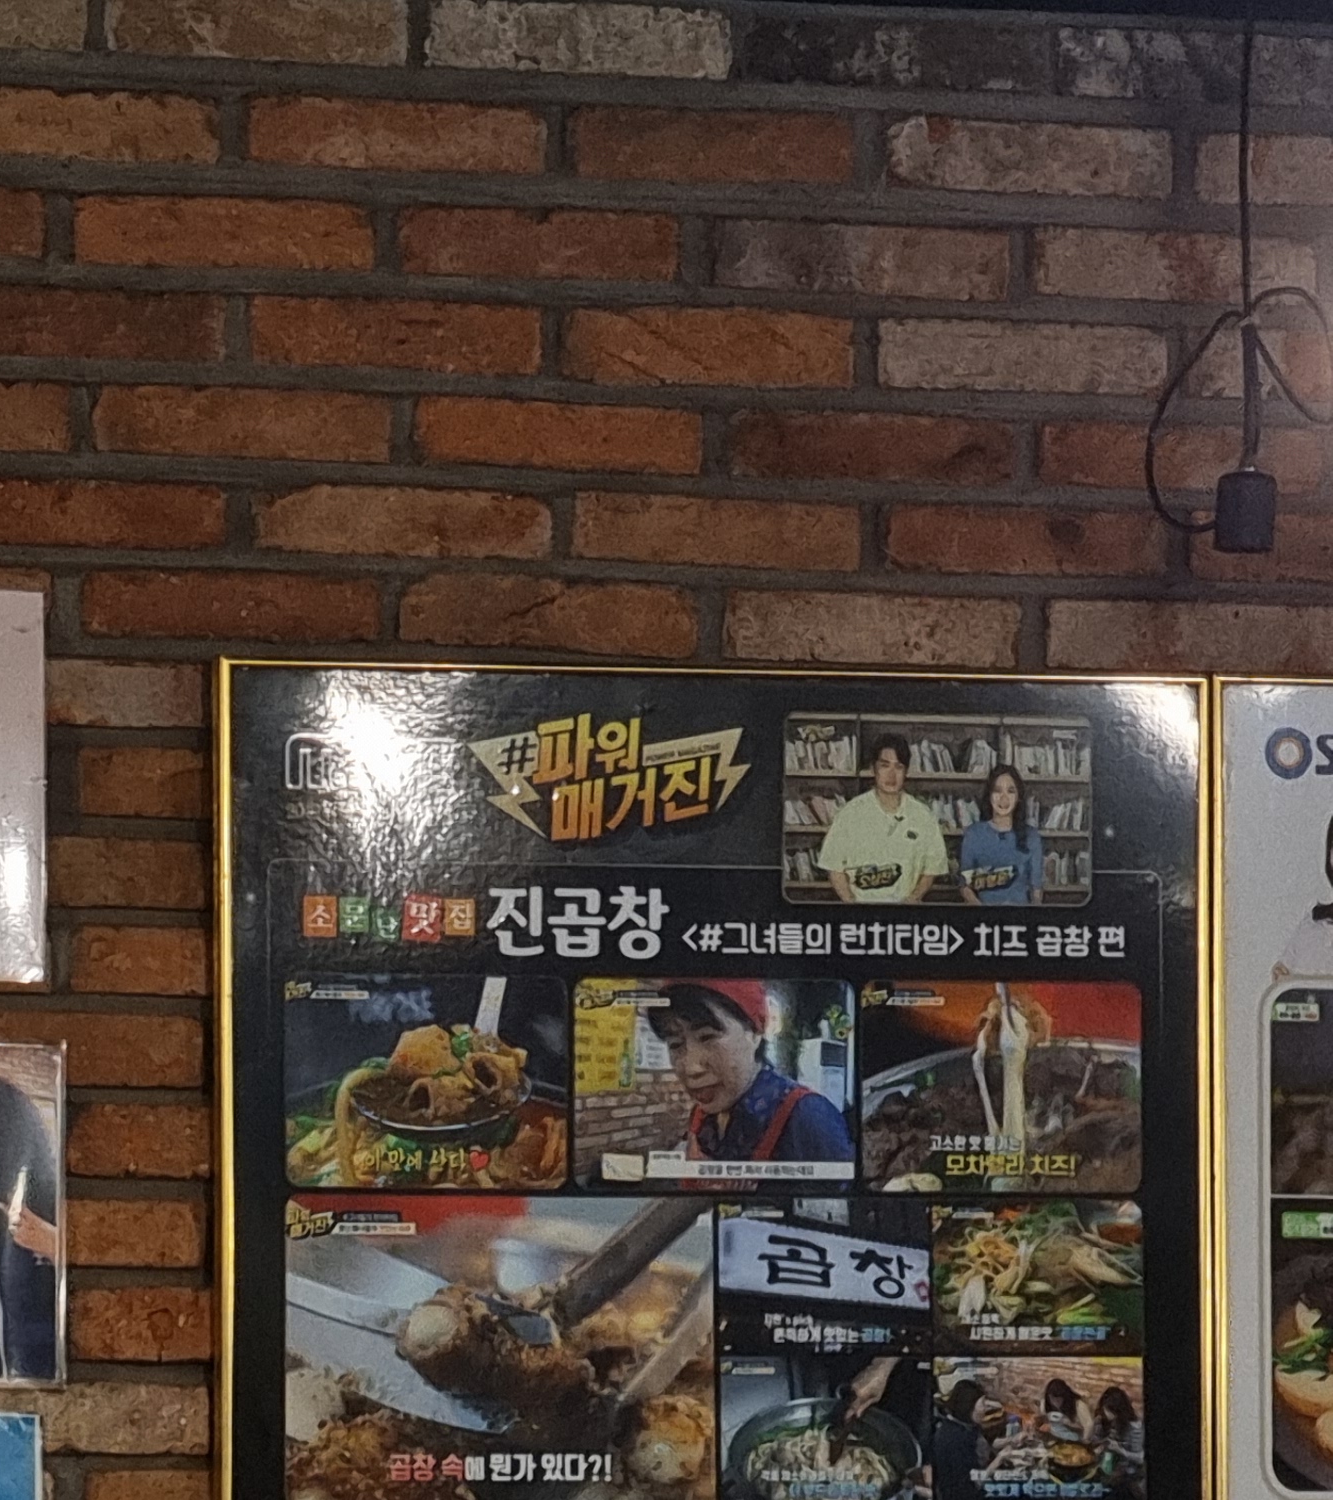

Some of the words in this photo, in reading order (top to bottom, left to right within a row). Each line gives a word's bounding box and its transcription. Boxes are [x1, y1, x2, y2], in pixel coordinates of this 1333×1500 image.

[550, 754, 714, 842] 매거진
[486, 886, 671, 959] 진곱창
[839, 921, 966, 957] 런치타임>
[973, 924, 1029, 958] 치즈
[1036, 924, 1093, 958] 곱창
[1098, 925, 1127, 958] 편
[1029, 1154, 1077, 1178] 치즈!
[757, 1234, 914, 1299] 곱창
[389, 1452, 437, 1482] 곱창
[441, 1453, 486, 1482] 속에
[489, 1453, 538, 1482] 뭔가
[540, 1453, 614, 1482] 있다?!
